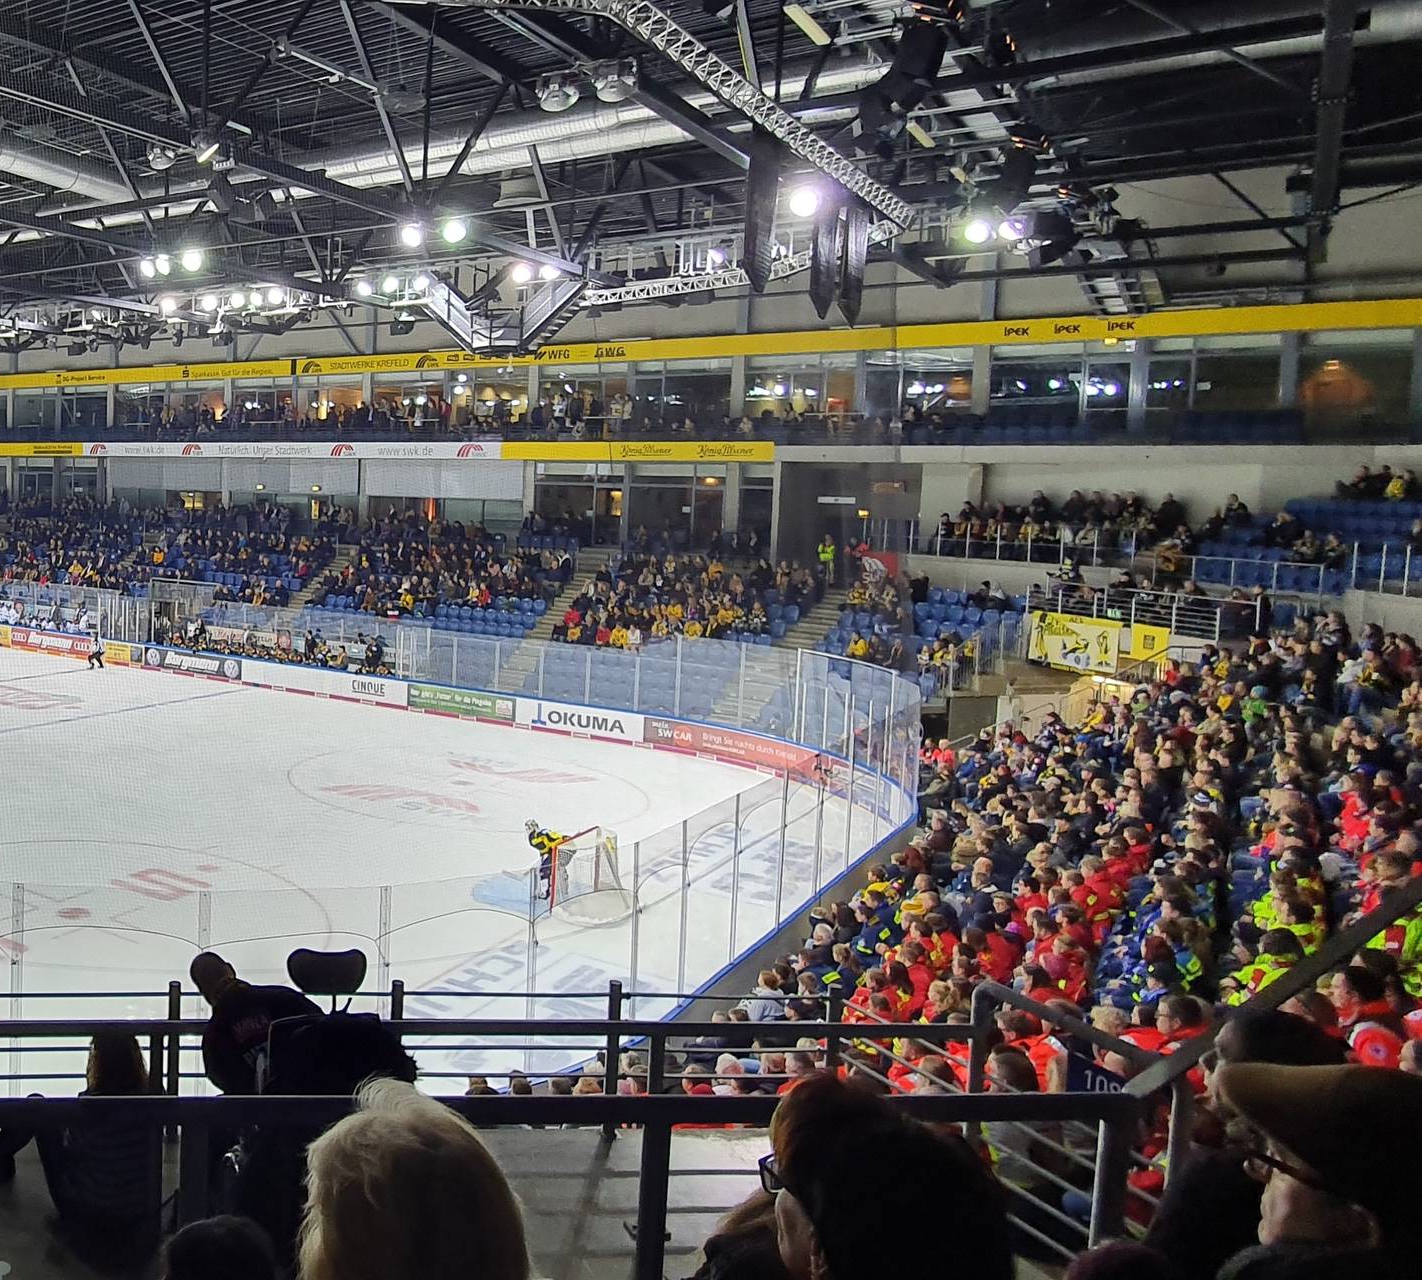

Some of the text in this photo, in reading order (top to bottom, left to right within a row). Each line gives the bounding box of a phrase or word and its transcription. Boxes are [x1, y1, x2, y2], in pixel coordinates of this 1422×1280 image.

[548, 350, 570, 360] WFG
[330, 358, 410, 370] STADTWERKE KREFELD
[378, 445, 434, 456] www.swk.de
[697, 444, 721, 457] König
[351, 679, 386, 695] CINQUE
[547, 710, 625, 734] OKUMA
